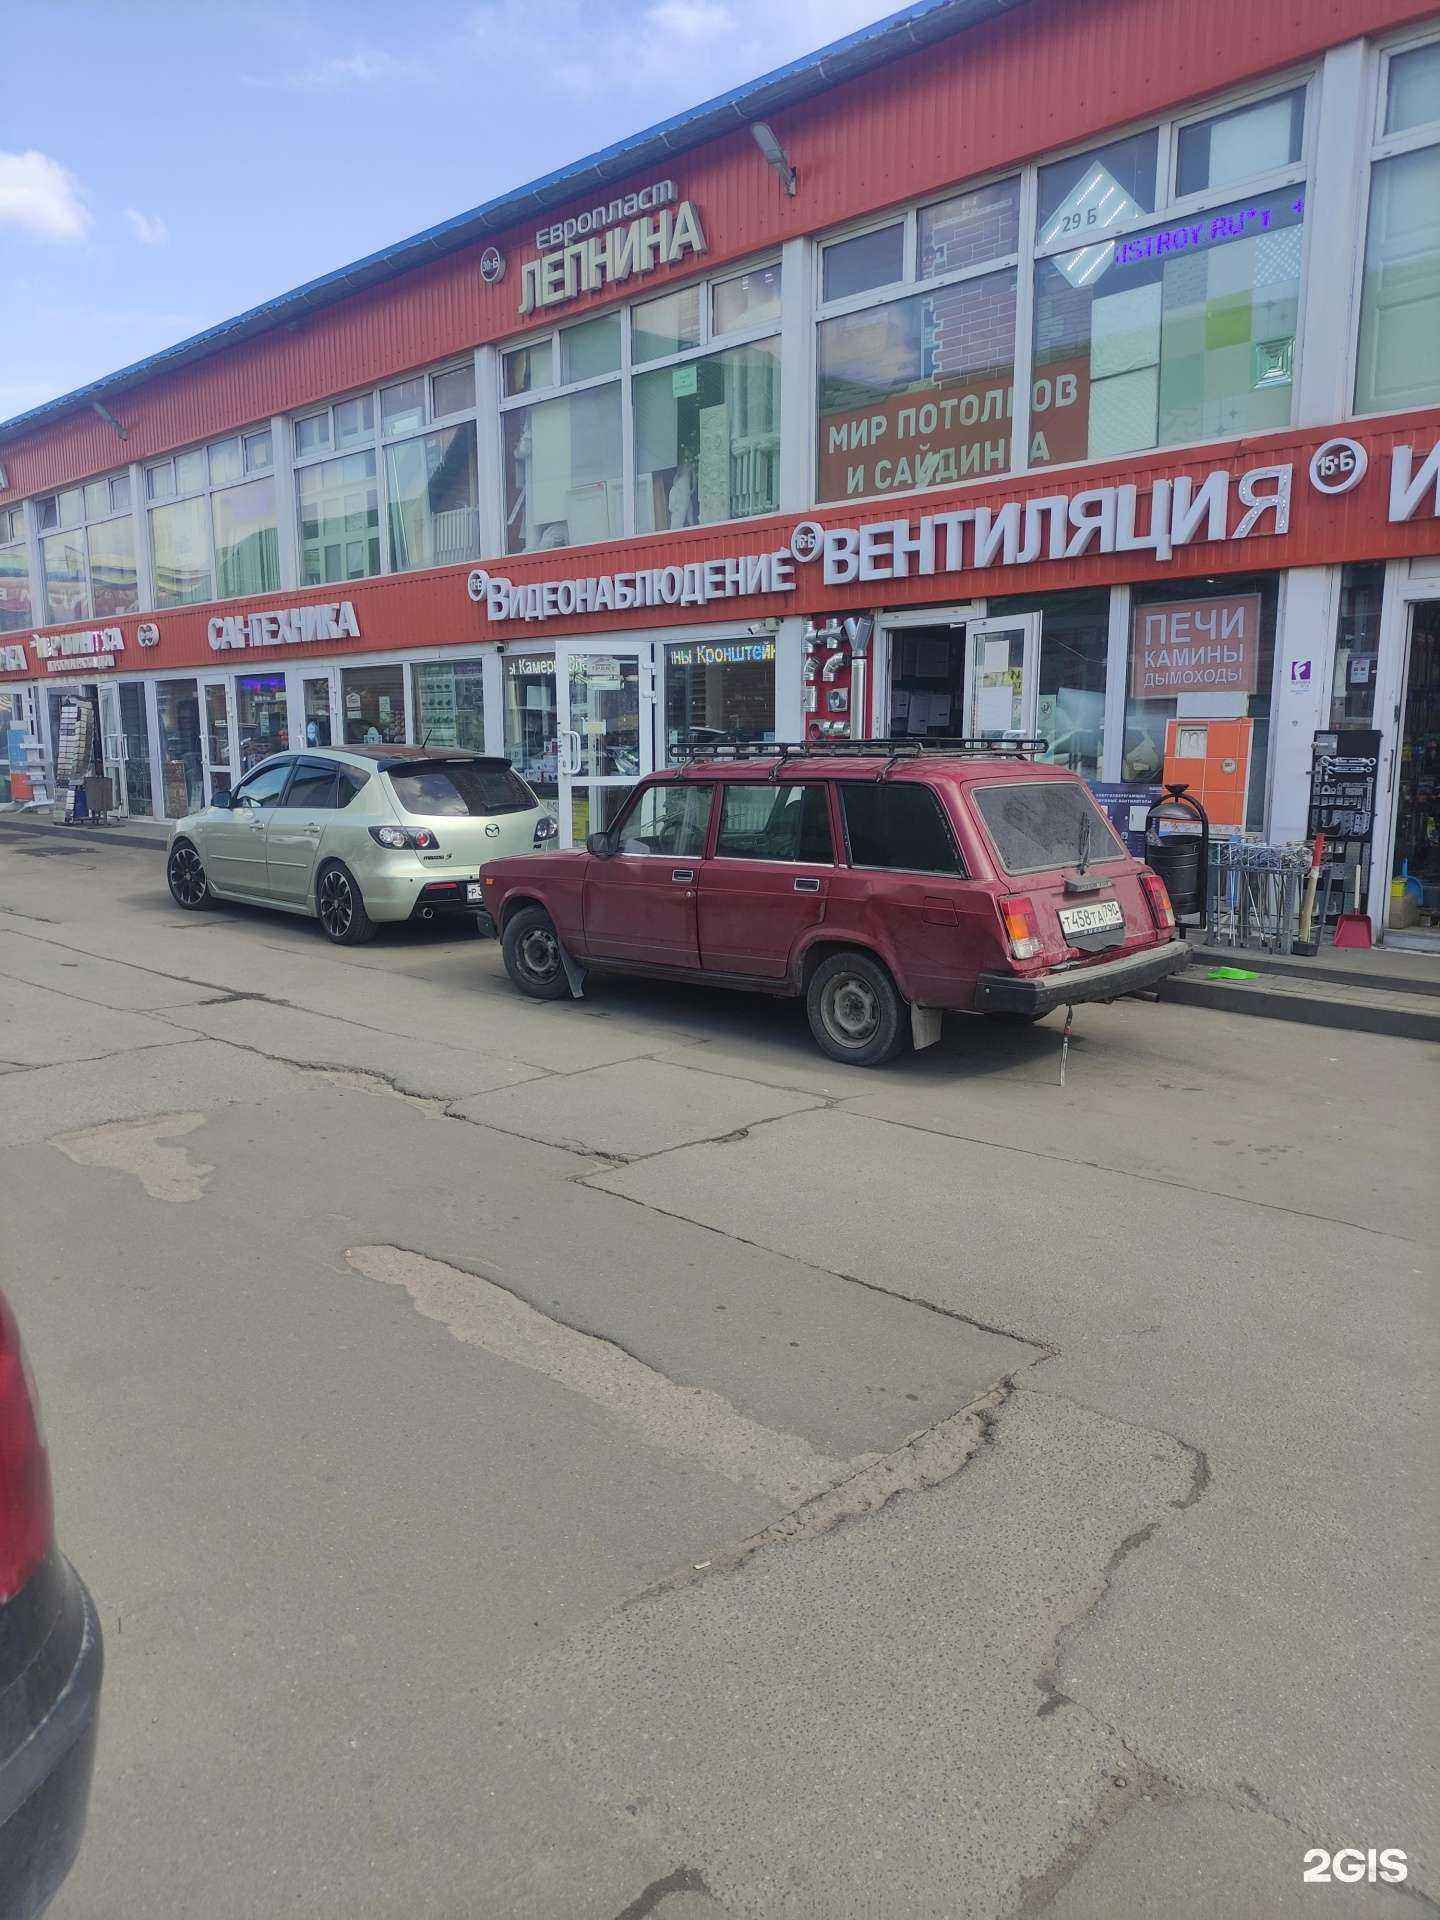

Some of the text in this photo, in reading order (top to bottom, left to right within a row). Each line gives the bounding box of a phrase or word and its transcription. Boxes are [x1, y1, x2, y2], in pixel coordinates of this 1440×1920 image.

[1062, 208, 1097, 232] 29 Б
[517, 200, 708, 315] ЛЕПНИНА
[826, 374, 1077, 454] МИР ПОТОЛОВ
[845, 431, 1050, 494] И САЙДИНА
[818, 463, 1290, 585] ВЕНТИЛЯЦИЯ
[206, 601, 360, 650] САНТЕХНИКА
[1145, 606, 1246, 646] ПЕЧИ
[1143, 668, 1242, 688] ДЫМОХОДЫ
[1144, 644, 1244, 668] КАМИНЫ
